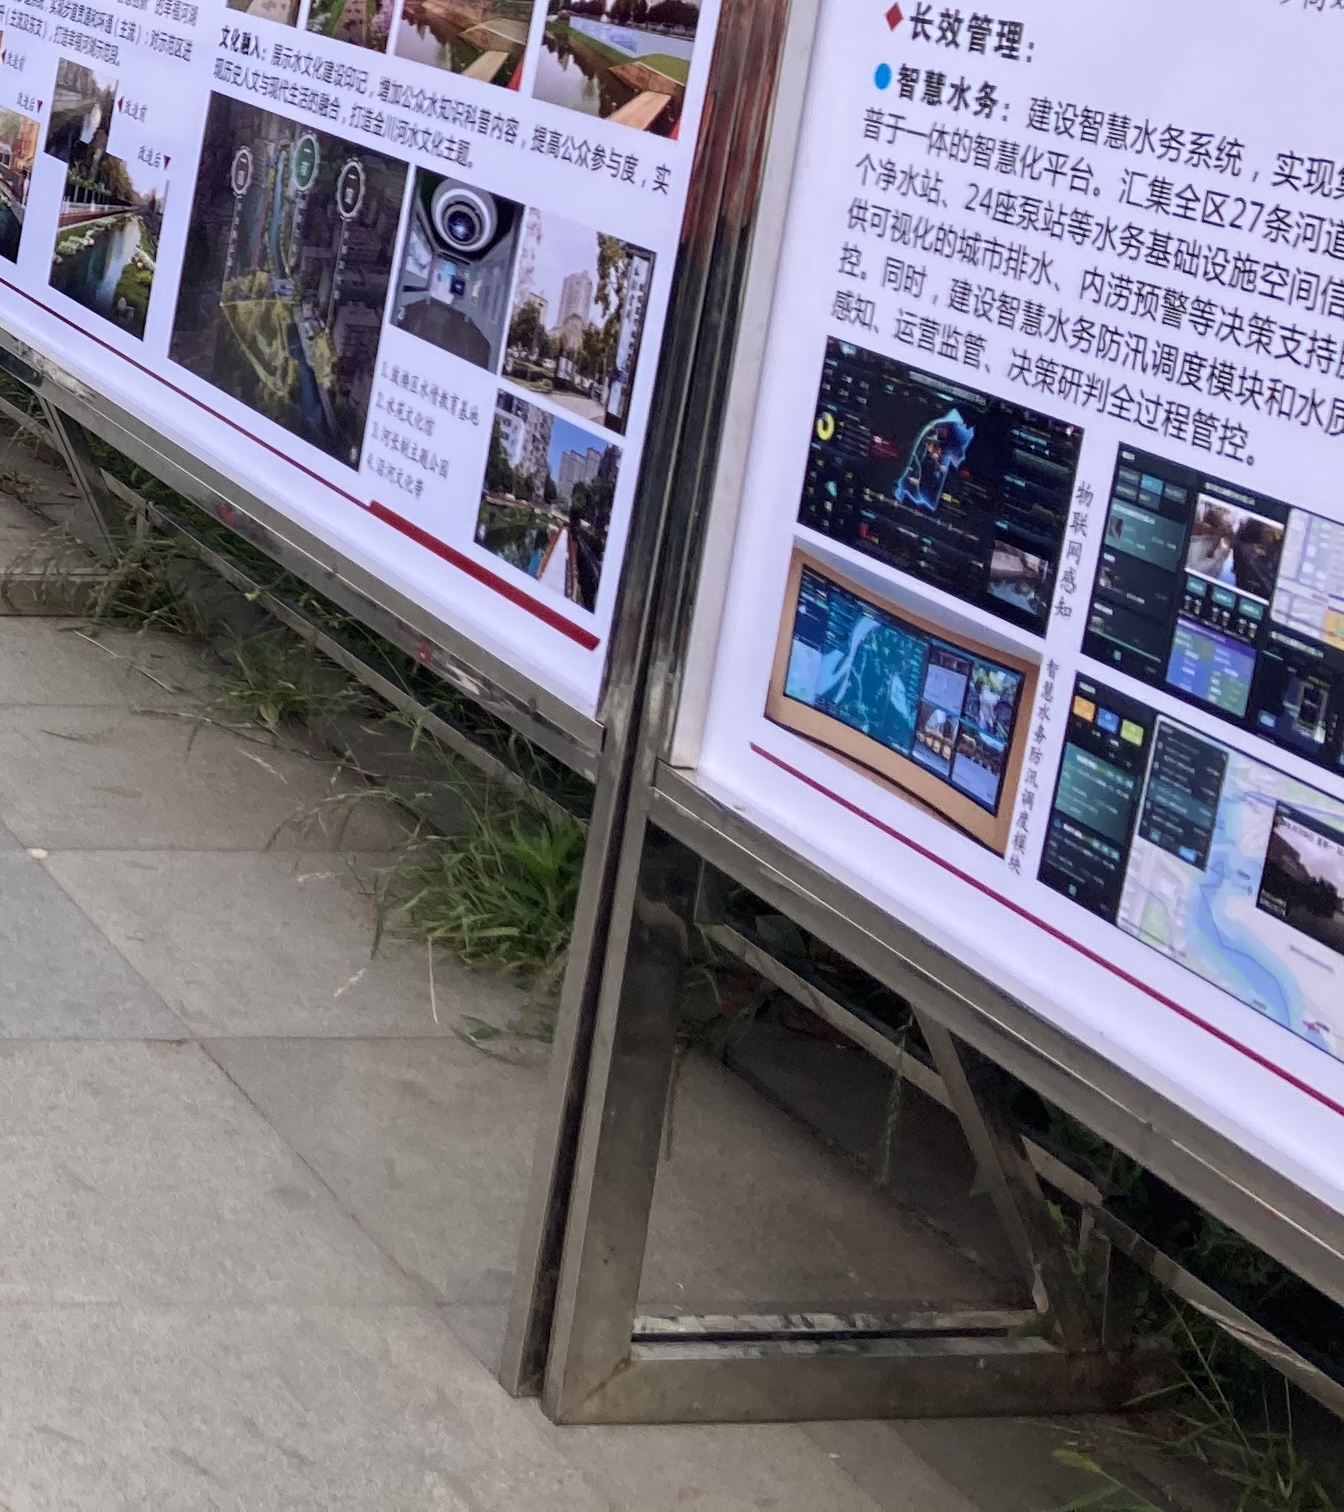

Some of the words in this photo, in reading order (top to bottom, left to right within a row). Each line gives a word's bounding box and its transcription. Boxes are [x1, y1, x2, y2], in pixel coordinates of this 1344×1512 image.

[909, 1, 1035, 63] 长效管理：
[896, 63, 1344, 200] 智慧水务：建设智慧水务系统，实现
[847, 197, 1344, 380] 供可视化的城市排水、内涝预警等决策支持
